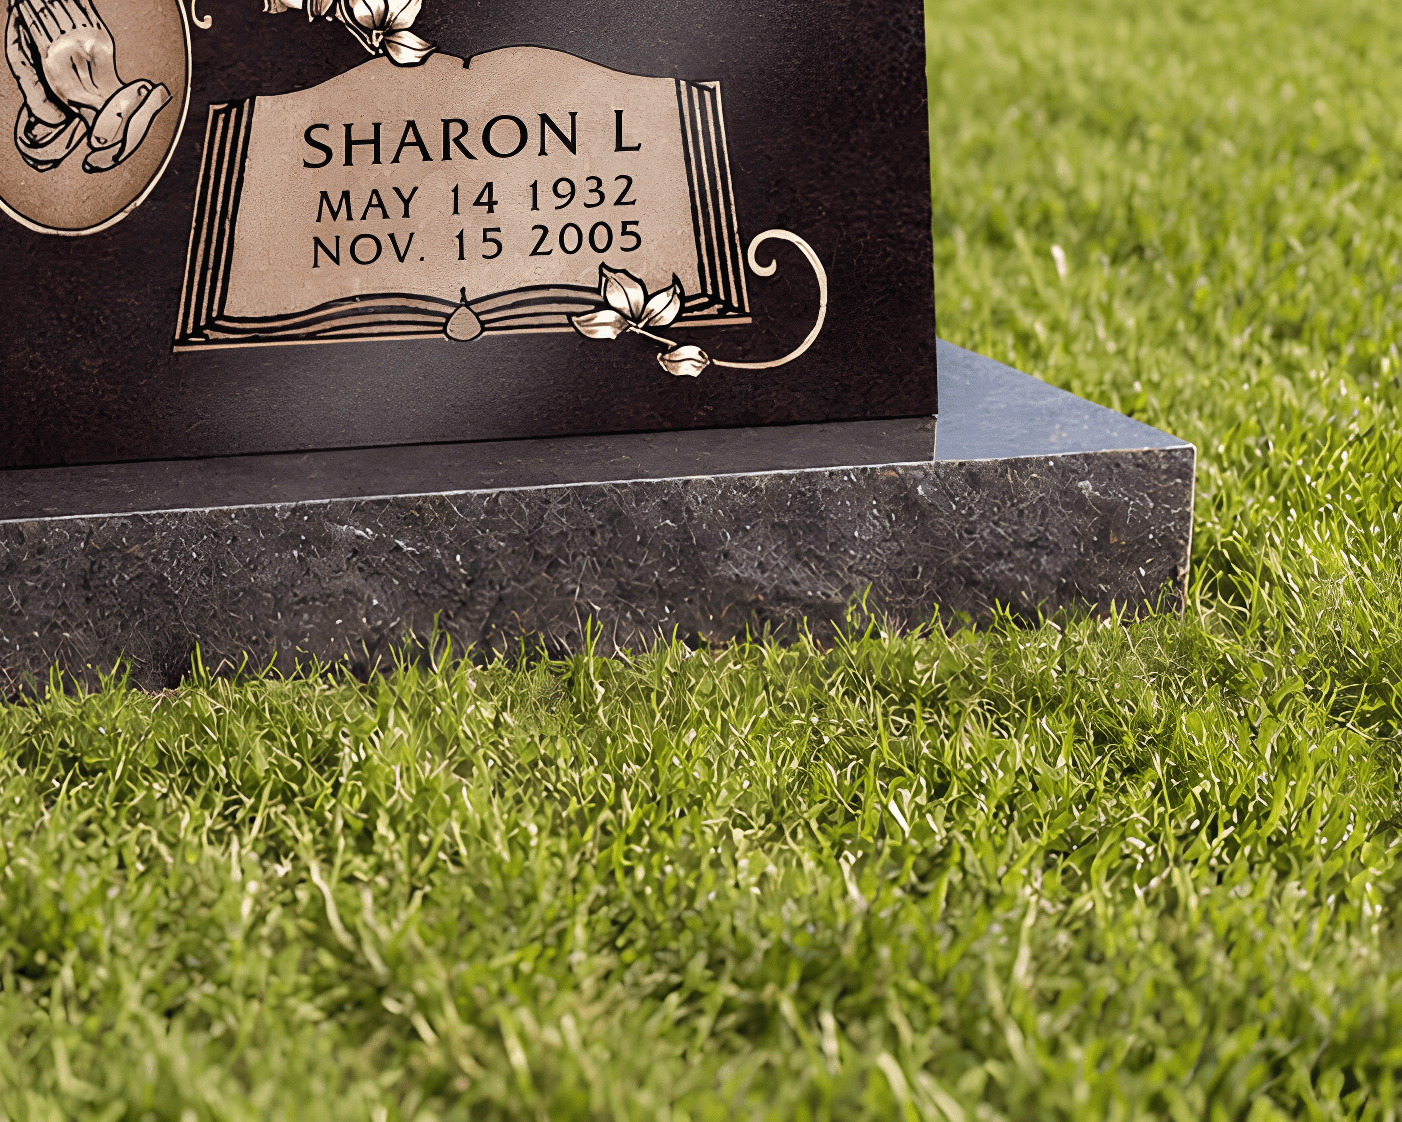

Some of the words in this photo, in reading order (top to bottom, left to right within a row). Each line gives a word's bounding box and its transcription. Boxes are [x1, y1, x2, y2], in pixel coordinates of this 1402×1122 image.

[302, 111, 579, 169] SHARON
[613, 109, 642, 153] L
[315, 186, 419, 223] MAY
[451, 181, 499, 216] 14
[529, 174, 637, 212] 1932
[311, 231, 425, 269] NOV.
[454, 226, 503, 261] 15
[528, 220, 642, 257] 2005
